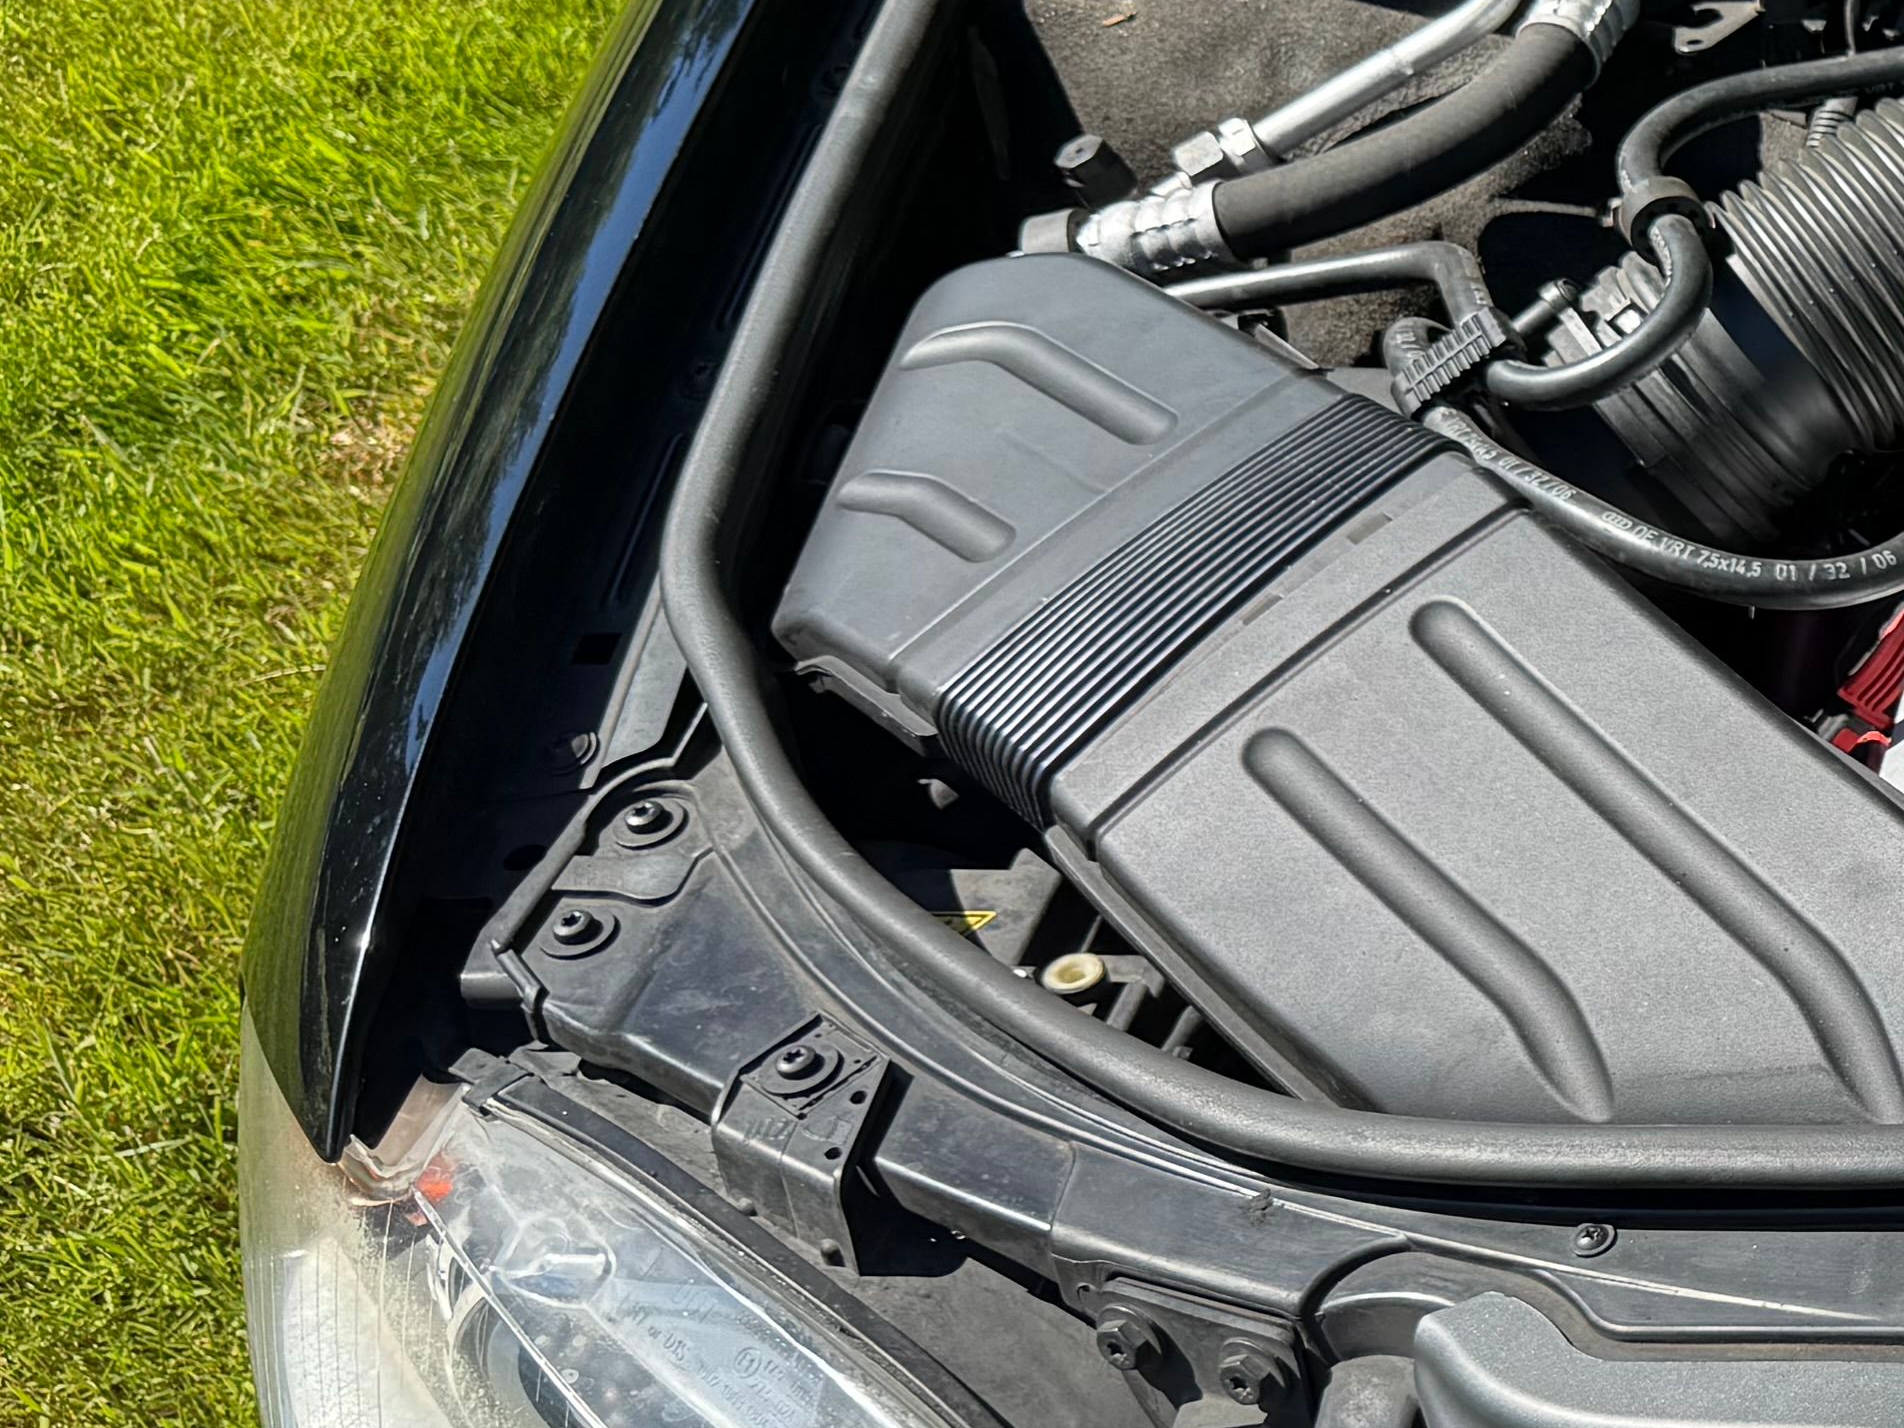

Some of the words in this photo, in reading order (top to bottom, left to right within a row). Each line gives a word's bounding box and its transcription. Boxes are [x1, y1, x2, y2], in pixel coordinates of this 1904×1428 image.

[1634, 524, 1655, 543] OE
[1660, 537, 1693, 561] VRT
[1697, 550, 1763, 579] 7,5x14,5
[1775, 564, 1797, 582] 01
[1808, 564, 1817, 581] /
[1822, 562, 1851, 581] 32
[1860, 557, 1868, 575] /
[1872, 550, 1898, 571] 06
